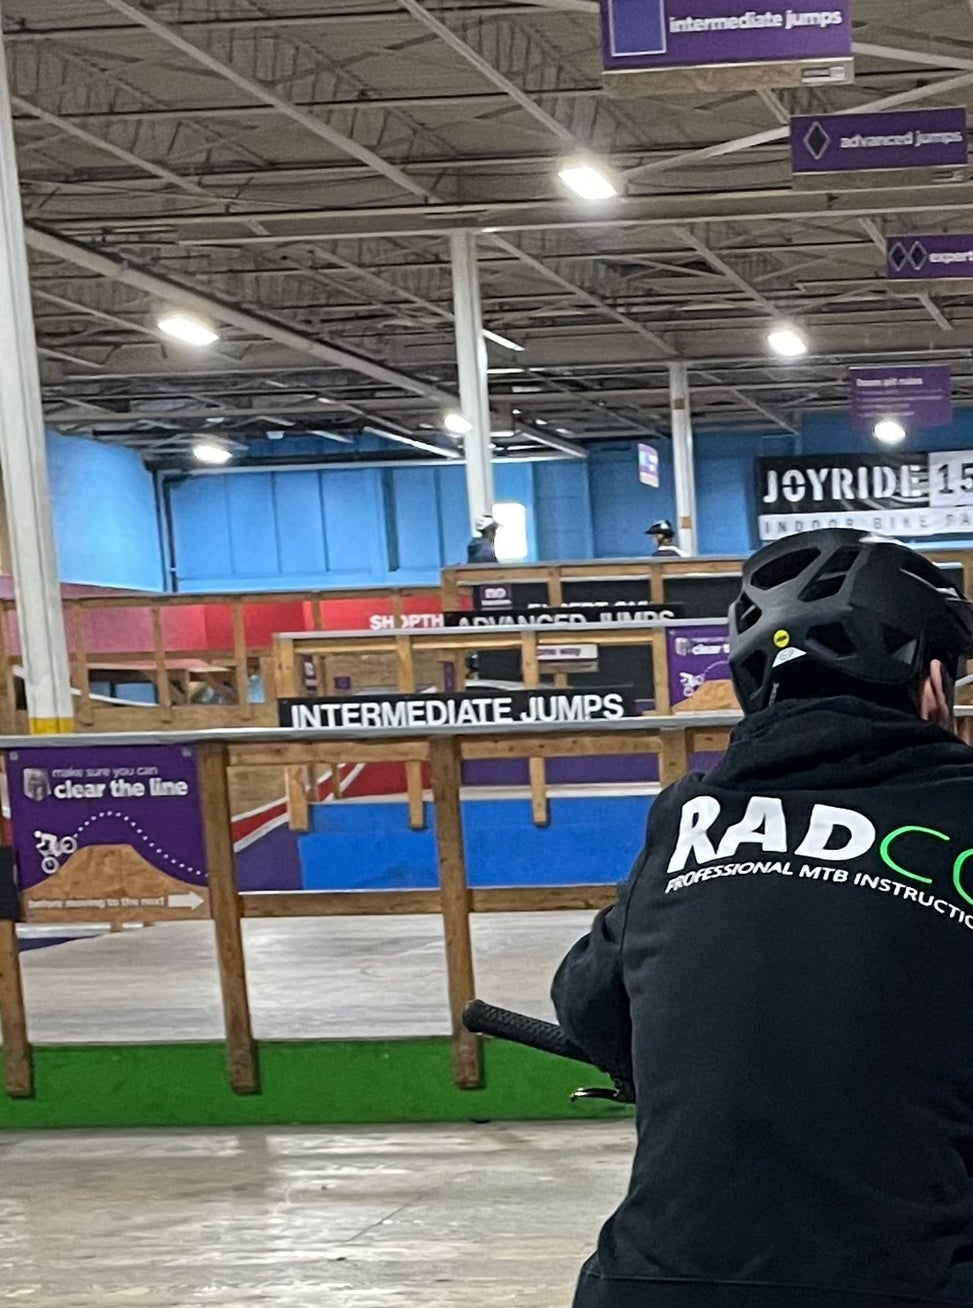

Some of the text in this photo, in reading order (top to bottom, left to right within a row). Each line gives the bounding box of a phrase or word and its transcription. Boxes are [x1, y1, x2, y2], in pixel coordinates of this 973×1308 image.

[669, 10, 843, 33] intermediate jumps
[840, 130, 963, 148] advanced jumps
[763, 464, 923, 503] JOYRIDE
[873, 513, 928, 530] BIKE
[292, 692, 624, 728] INTERMEDIATE JUMPS
[52, 766, 158, 778] make sure you can
[54, 777, 188, 799] clear the line
[665, 861, 793, 894] PROFESSIONAL
[799, 864, 849, 883] MTB
